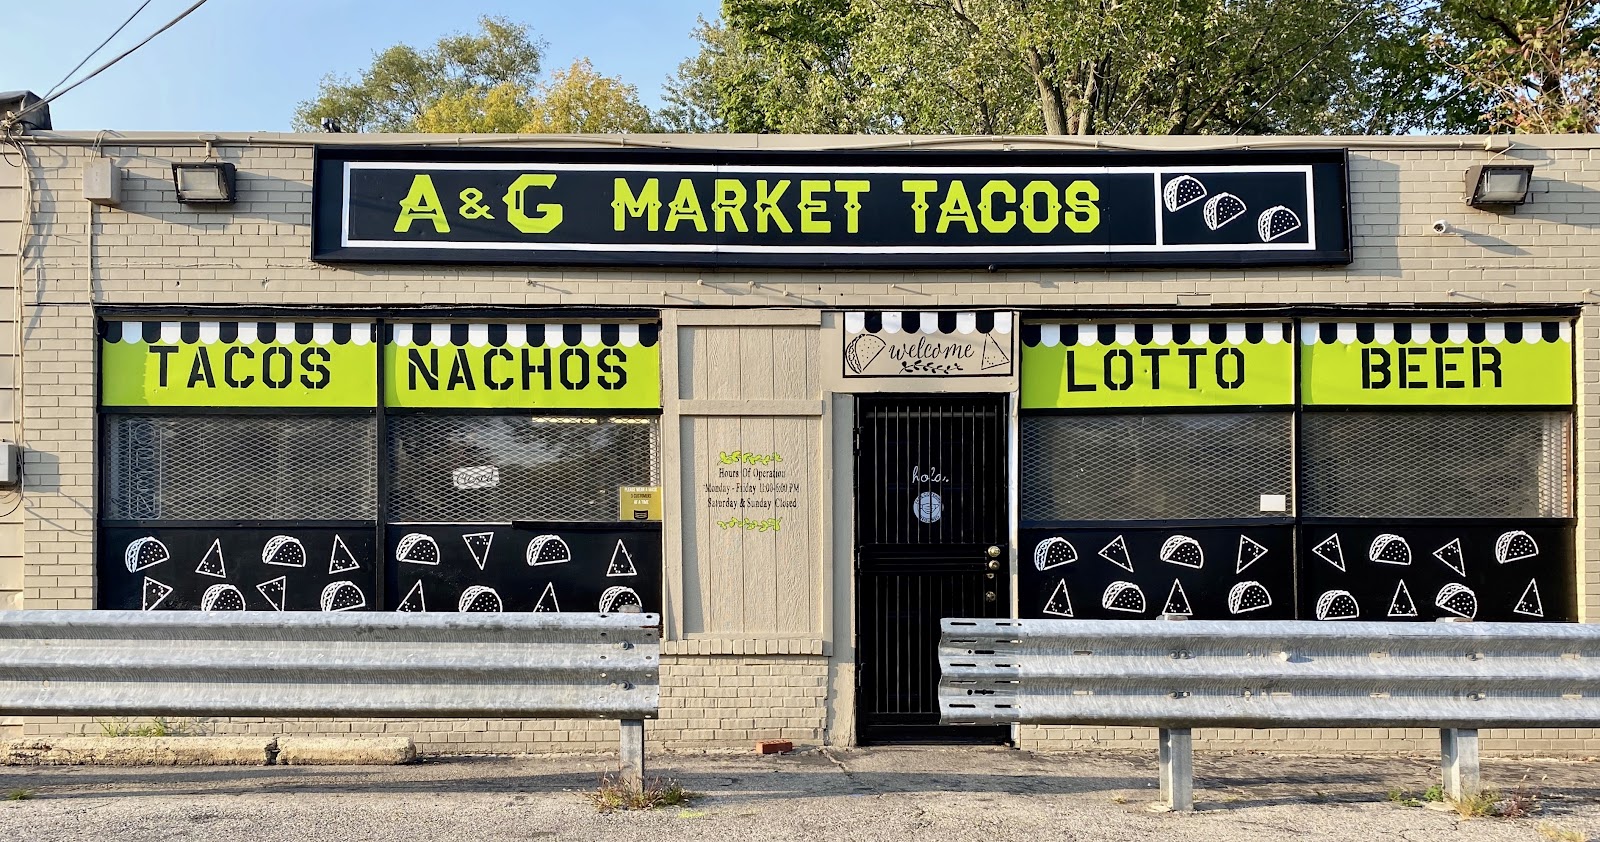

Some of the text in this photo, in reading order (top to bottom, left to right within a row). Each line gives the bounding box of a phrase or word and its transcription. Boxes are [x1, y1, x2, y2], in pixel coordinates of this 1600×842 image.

[612, 178, 870, 234] MARKET
[902, 180, 1099, 233] TACOS
[150, 346, 330, 389] TACOS
[409, 348, 627, 390] NACHOS
[889, 336, 975, 360] welcome
[1362, 347, 1502, 389] BEER
[1067, 348, 1245, 392] LOTTO
[719, 467, 786, 480] Hours Of Operation
[736, 482, 756, 495] Friday
[789, 482, 800, 493] PM
[708, 497, 797, 510] Saturday & Sunday Closed
